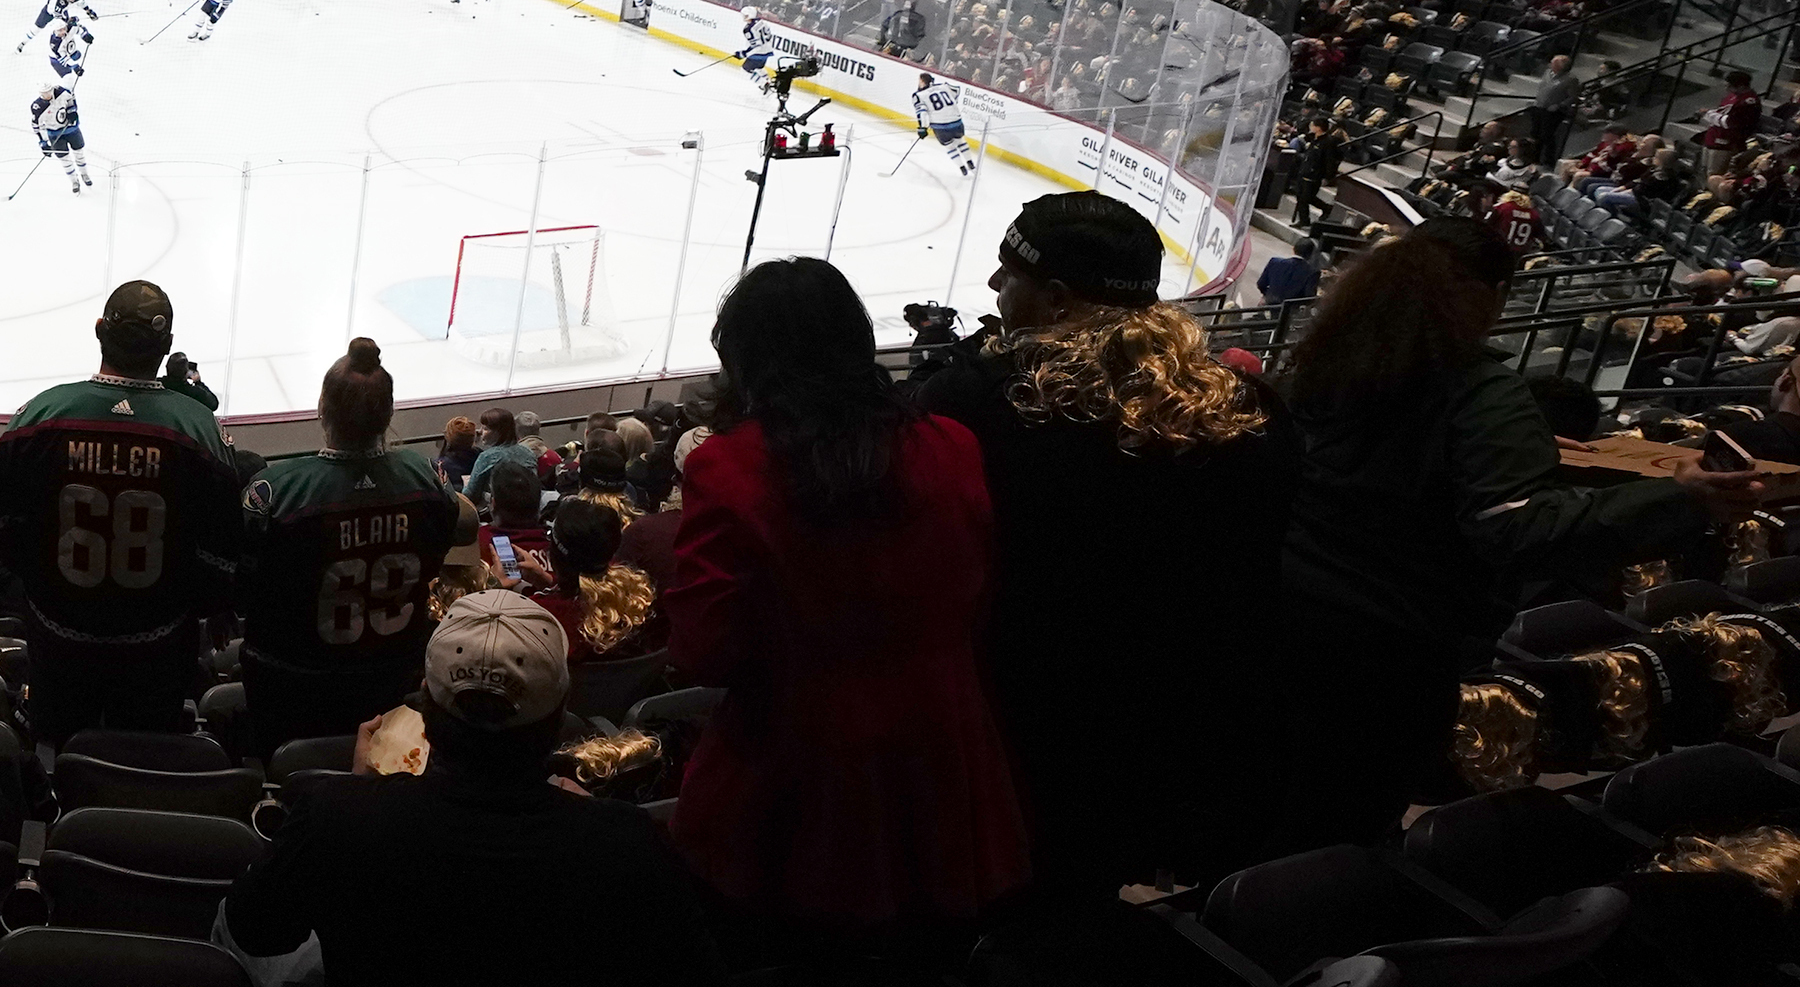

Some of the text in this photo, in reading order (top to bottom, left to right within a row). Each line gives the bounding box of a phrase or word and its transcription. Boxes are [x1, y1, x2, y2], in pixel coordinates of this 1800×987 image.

[651, 0, 718, 29] hoenix Children's
[928, 90, 954, 111] 80
[962, 97, 1007, 120] BlueShield
[964, 87, 1005, 107] BlueCross
[1109, 149, 1139, 172] RIVER
[1142, 166, 1164, 188] GILA
[1507, 220, 1532, 245] 19
[1104, 277, 1140, 291] YOU
[67, 439, 161, 478] MILLER
[57, 483, 168, 590] 68
[339, 513, 409, 552] BLAIR
[449, 667, 527, 697] LOS YOTES
